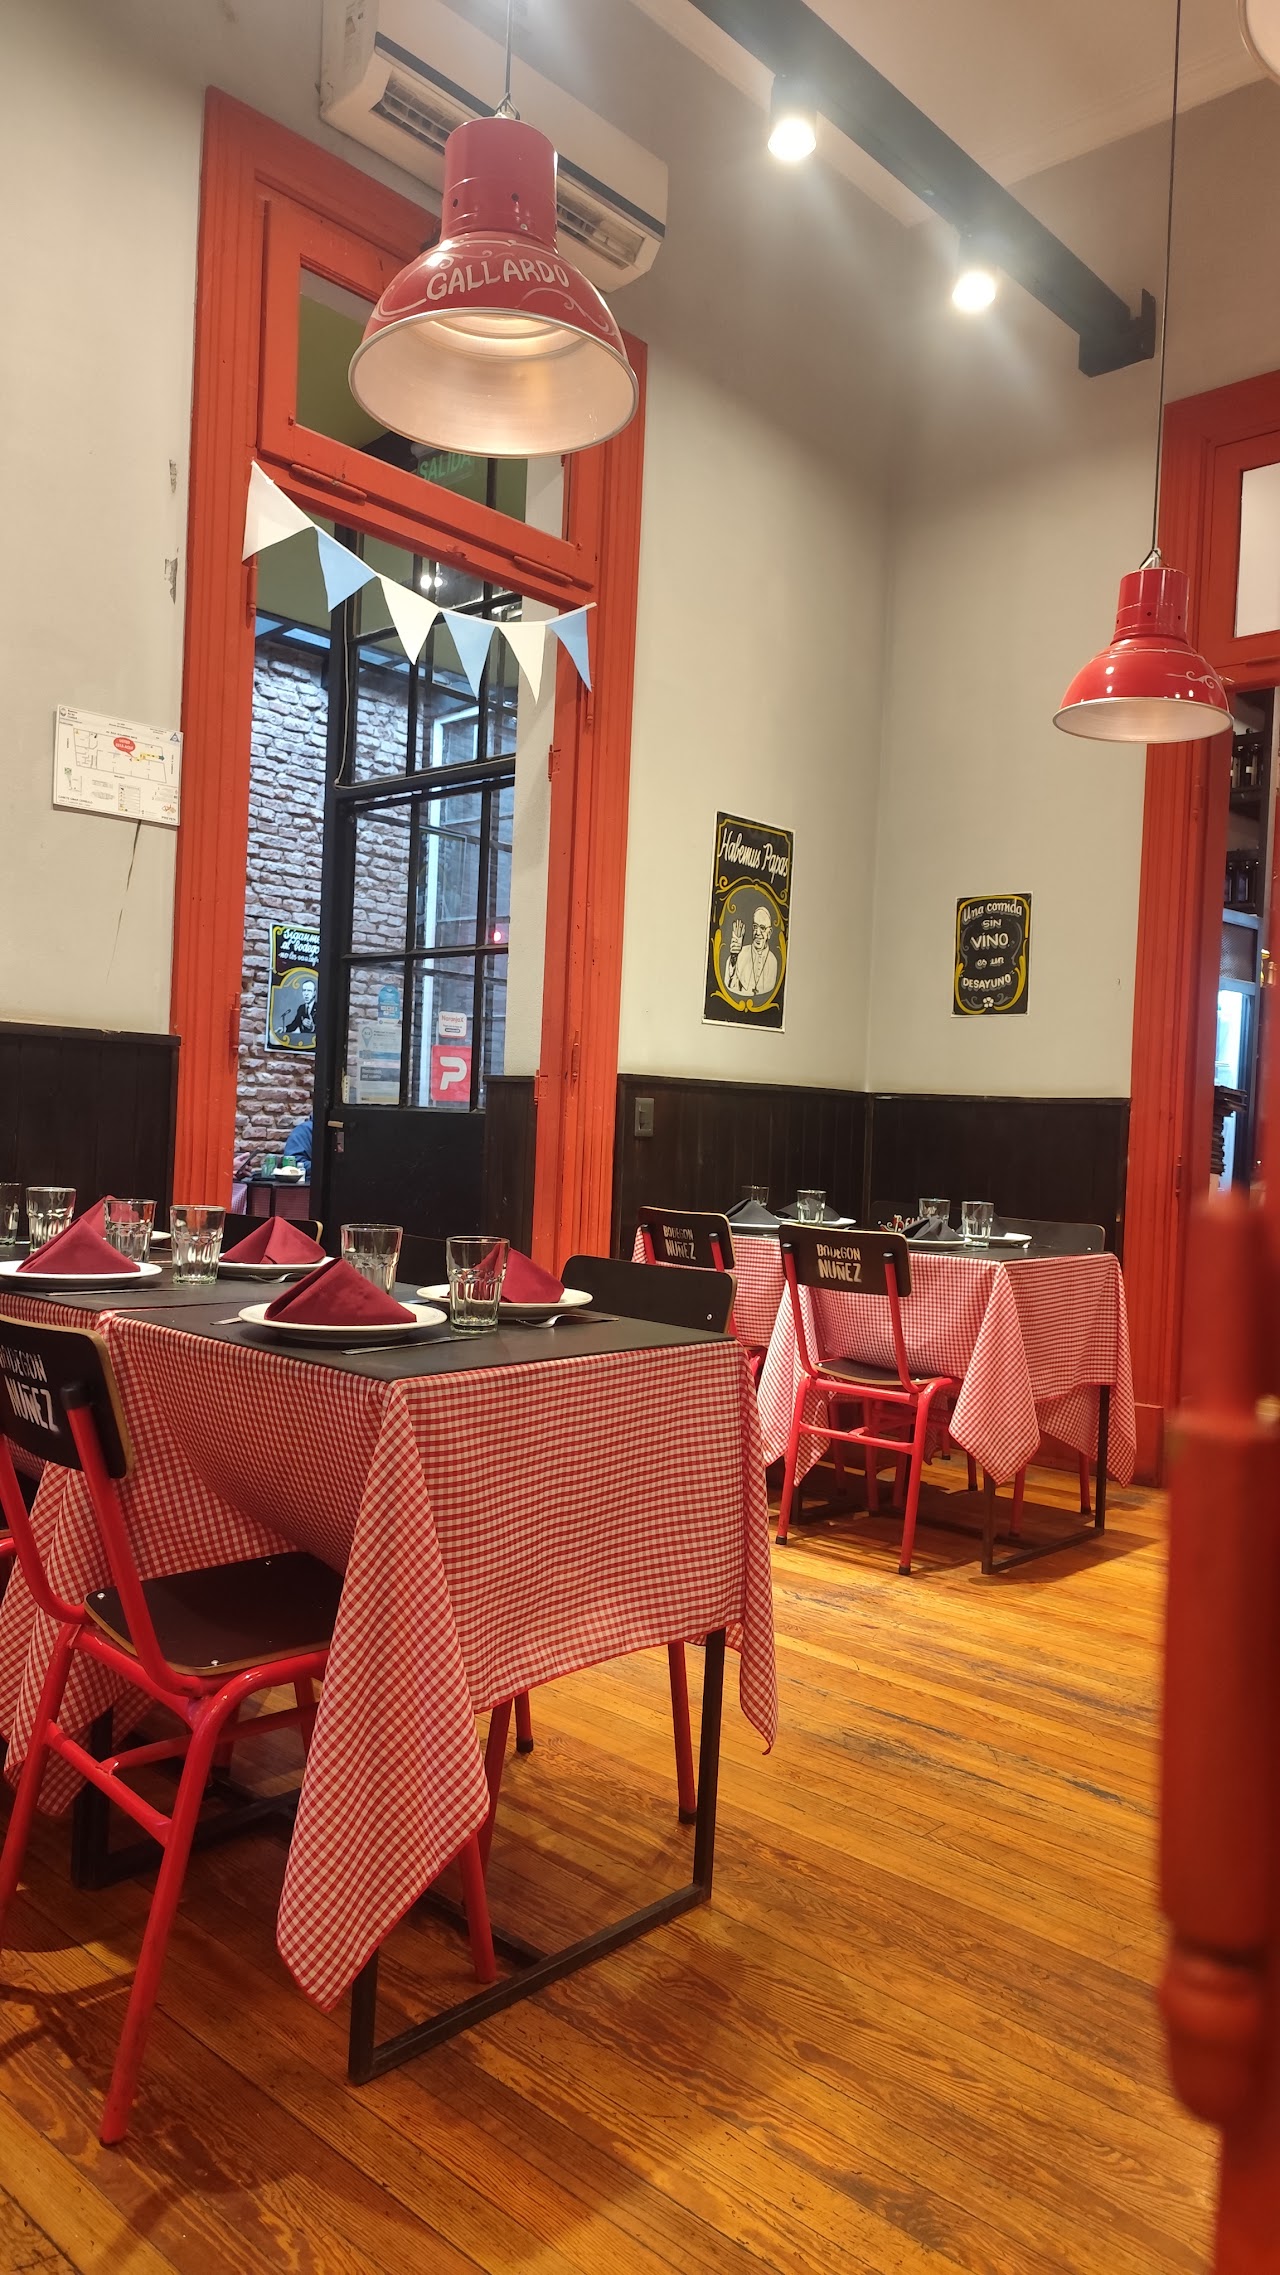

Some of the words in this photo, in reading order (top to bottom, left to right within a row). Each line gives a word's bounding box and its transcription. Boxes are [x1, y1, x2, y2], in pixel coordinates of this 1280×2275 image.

[426, 258, 570, 301] GALLARDO
[420, 453, 471, 481] SALIDA
[718, 827, 761, 870] Habemus
[761, 842, 789, 884] Papas
[963, 905, 984, 922] Una
[986, 898, 1023, 916] comida
[977, 958, 988, 967] es
[990, 956, 1005, 966] un
[816, 1243, 861, 1261] BODEGON
[818, 1258, 862, 1283] NUÑEZ
